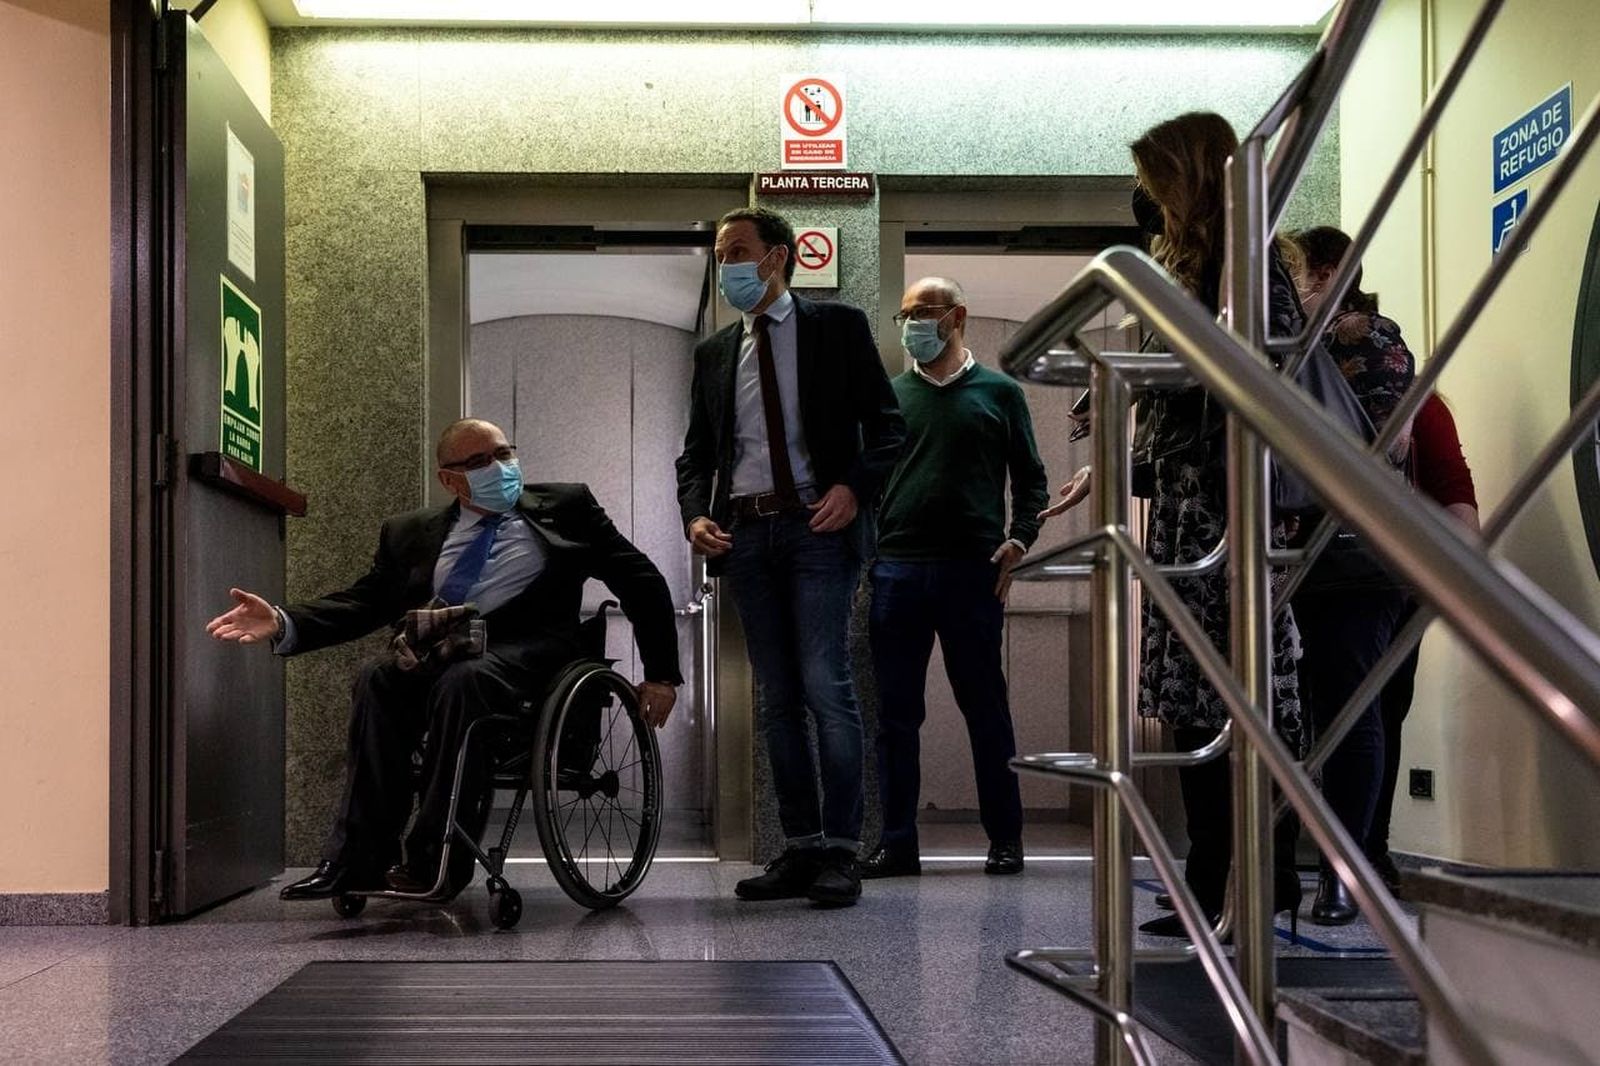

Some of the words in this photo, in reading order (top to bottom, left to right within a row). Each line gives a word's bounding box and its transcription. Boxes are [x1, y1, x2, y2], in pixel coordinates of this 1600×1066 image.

[1500, 119, 1539, 158] ZONA
[1542, 101, 1562, 128] DE
[1500, 126, 1563, 180] REFUGIO
[761, 176, 809, 189] PLANTA
[811, 176, 869, 189] TERCERA
